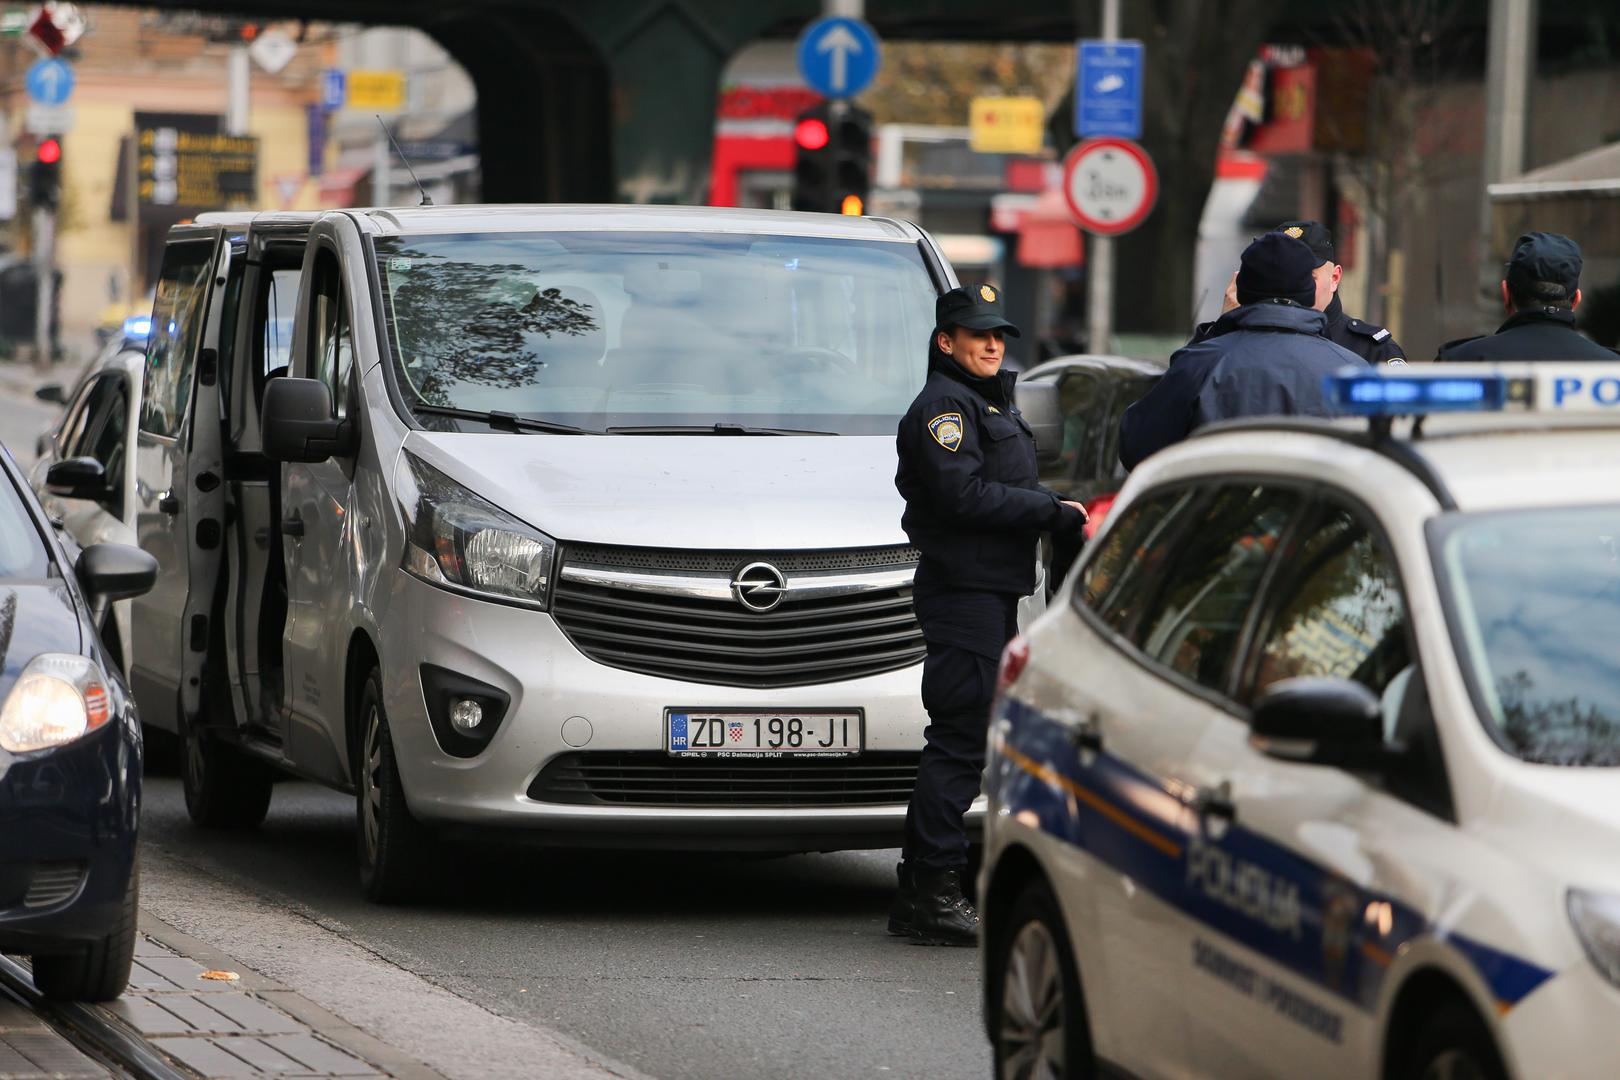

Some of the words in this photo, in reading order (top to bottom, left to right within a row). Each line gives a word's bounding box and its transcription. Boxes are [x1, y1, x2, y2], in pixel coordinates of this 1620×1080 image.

[930, 416, 959, 429] POLICIJA
[691, 718, 725, 748] ZD
[753, 718, 848, 748] 198-JI
[672, 736, 687, 746] HR
